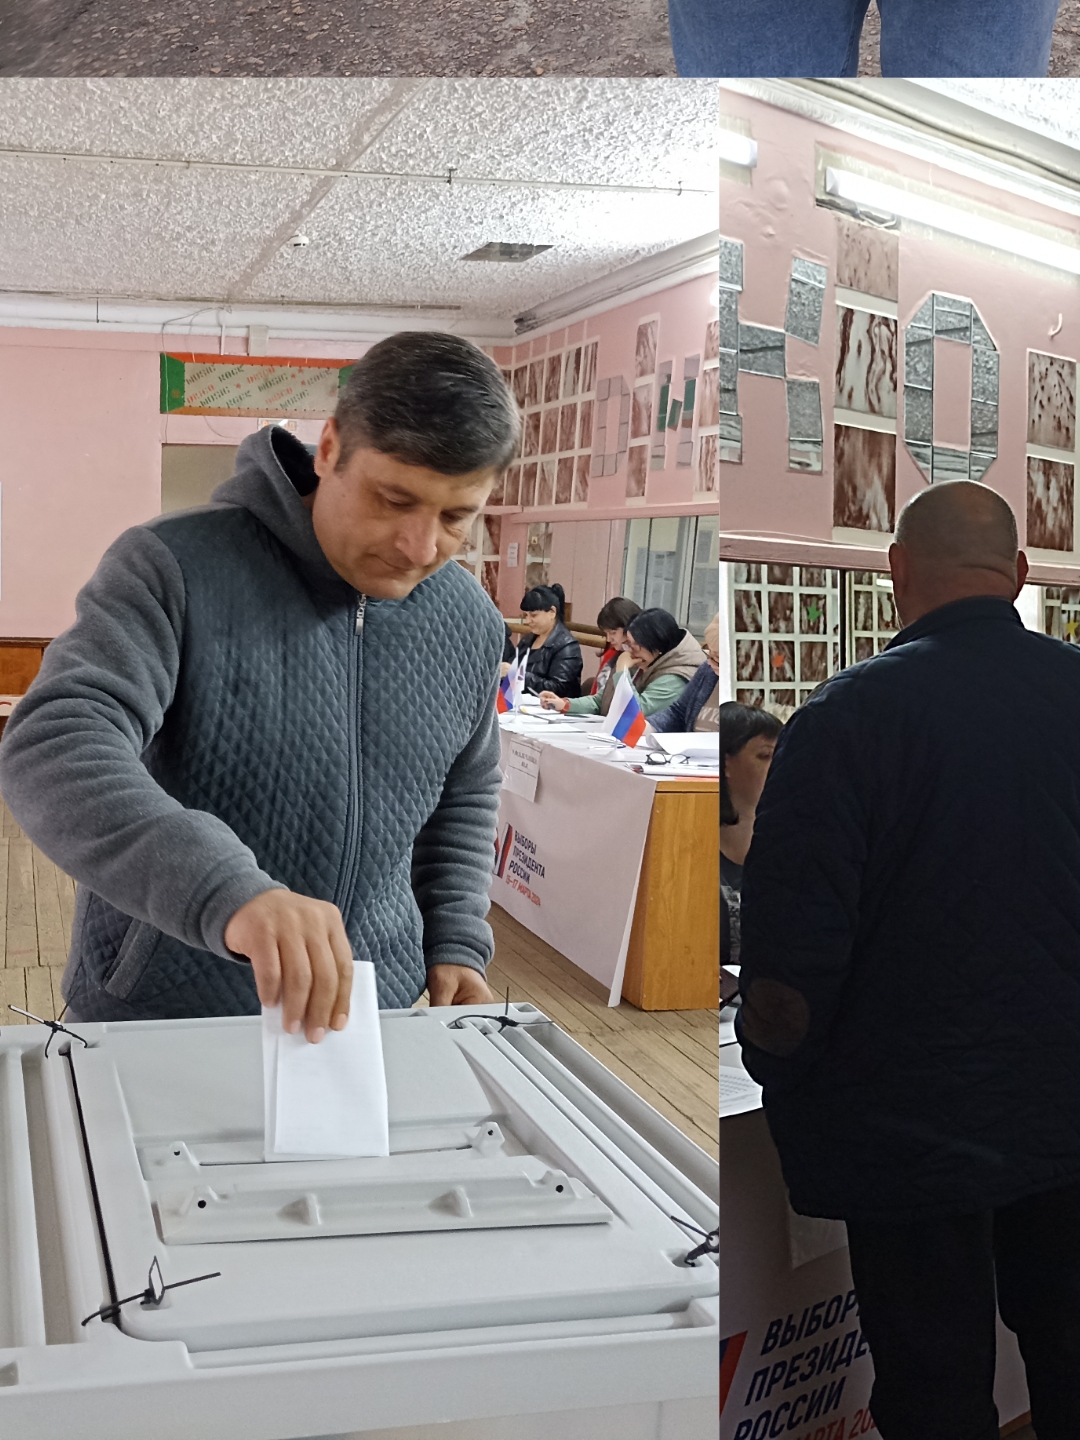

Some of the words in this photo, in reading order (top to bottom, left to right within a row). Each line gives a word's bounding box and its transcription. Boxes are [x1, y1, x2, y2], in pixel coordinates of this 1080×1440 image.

[514, 830, 537, 856] ВЫБОРЫ
[508, 860, 531, 885] РОССИИ
[513, 845, 546, 879] ПРЕЗИДЕНТА
[760, 1289, 860, 1356] ВЫБОР
[733, 1376, 847, 1440] РОССИИ
[848, 1407, 877, 1440] 20
